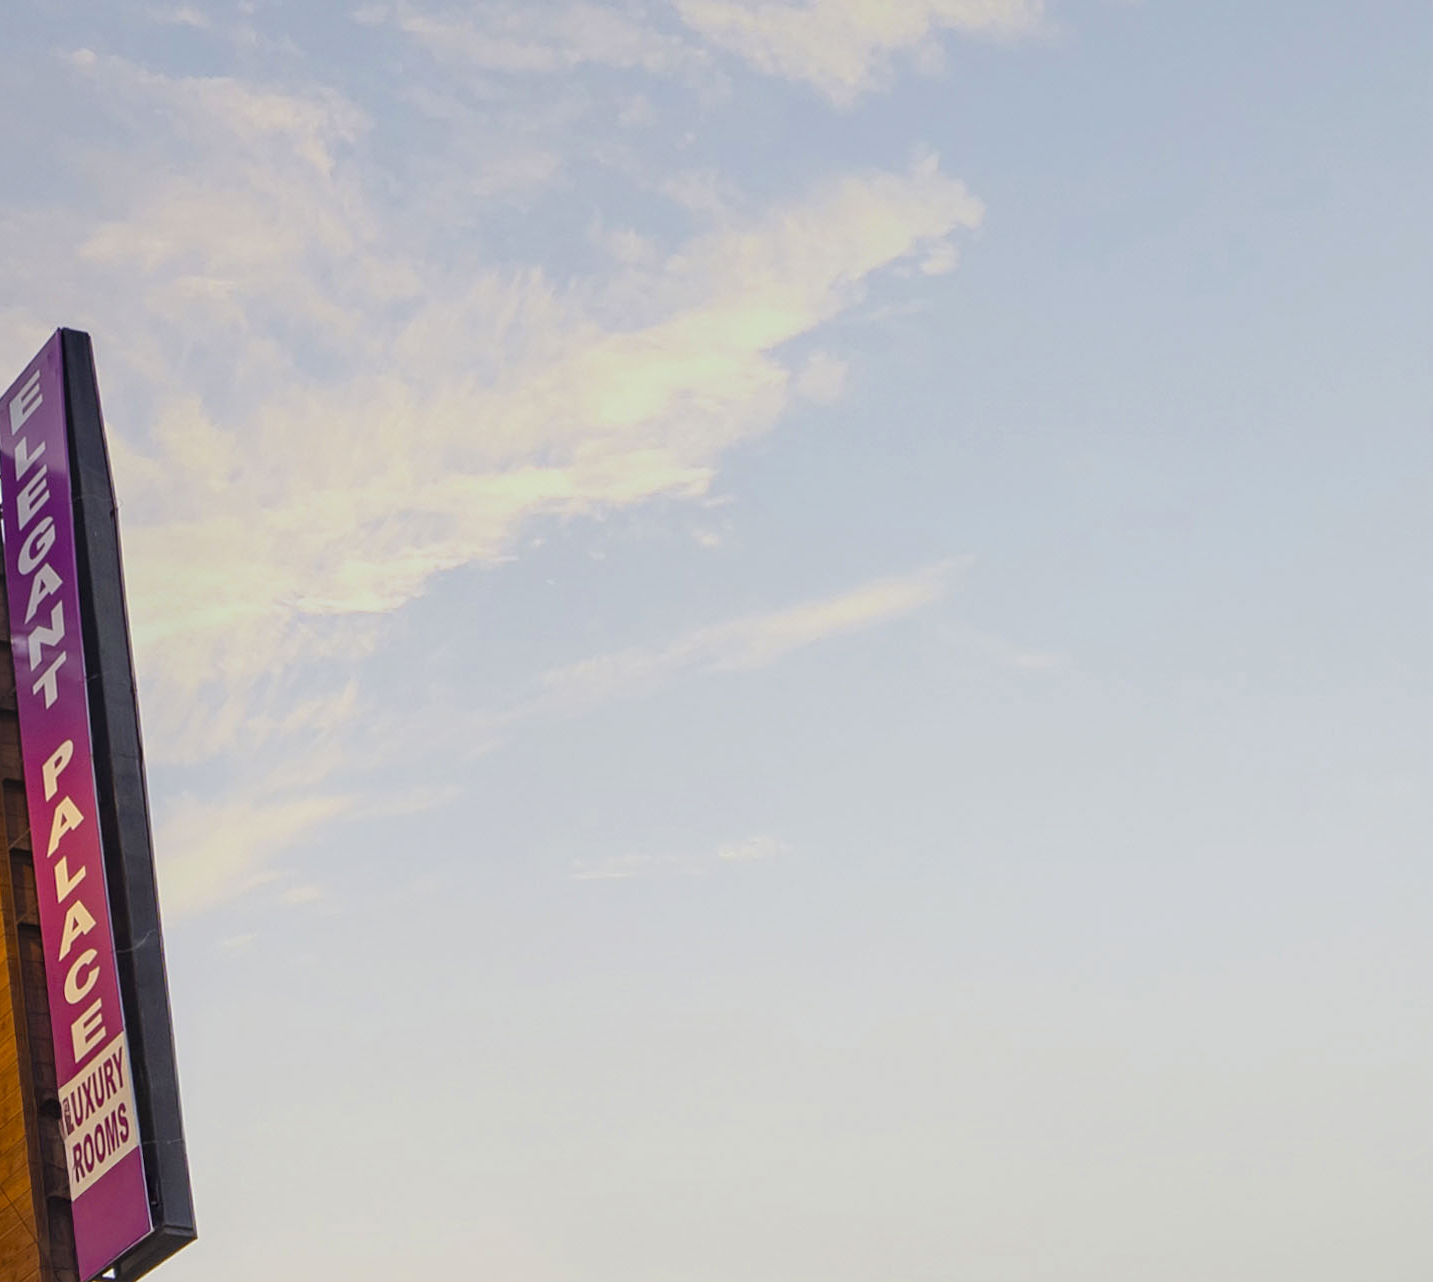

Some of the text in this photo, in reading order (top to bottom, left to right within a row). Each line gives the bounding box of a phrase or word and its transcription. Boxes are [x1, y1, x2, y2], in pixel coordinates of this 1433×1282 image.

[9, 369, 108, 1064] ELEGANT PALACE
[72, 1102, 130, 1184] ROOMS
